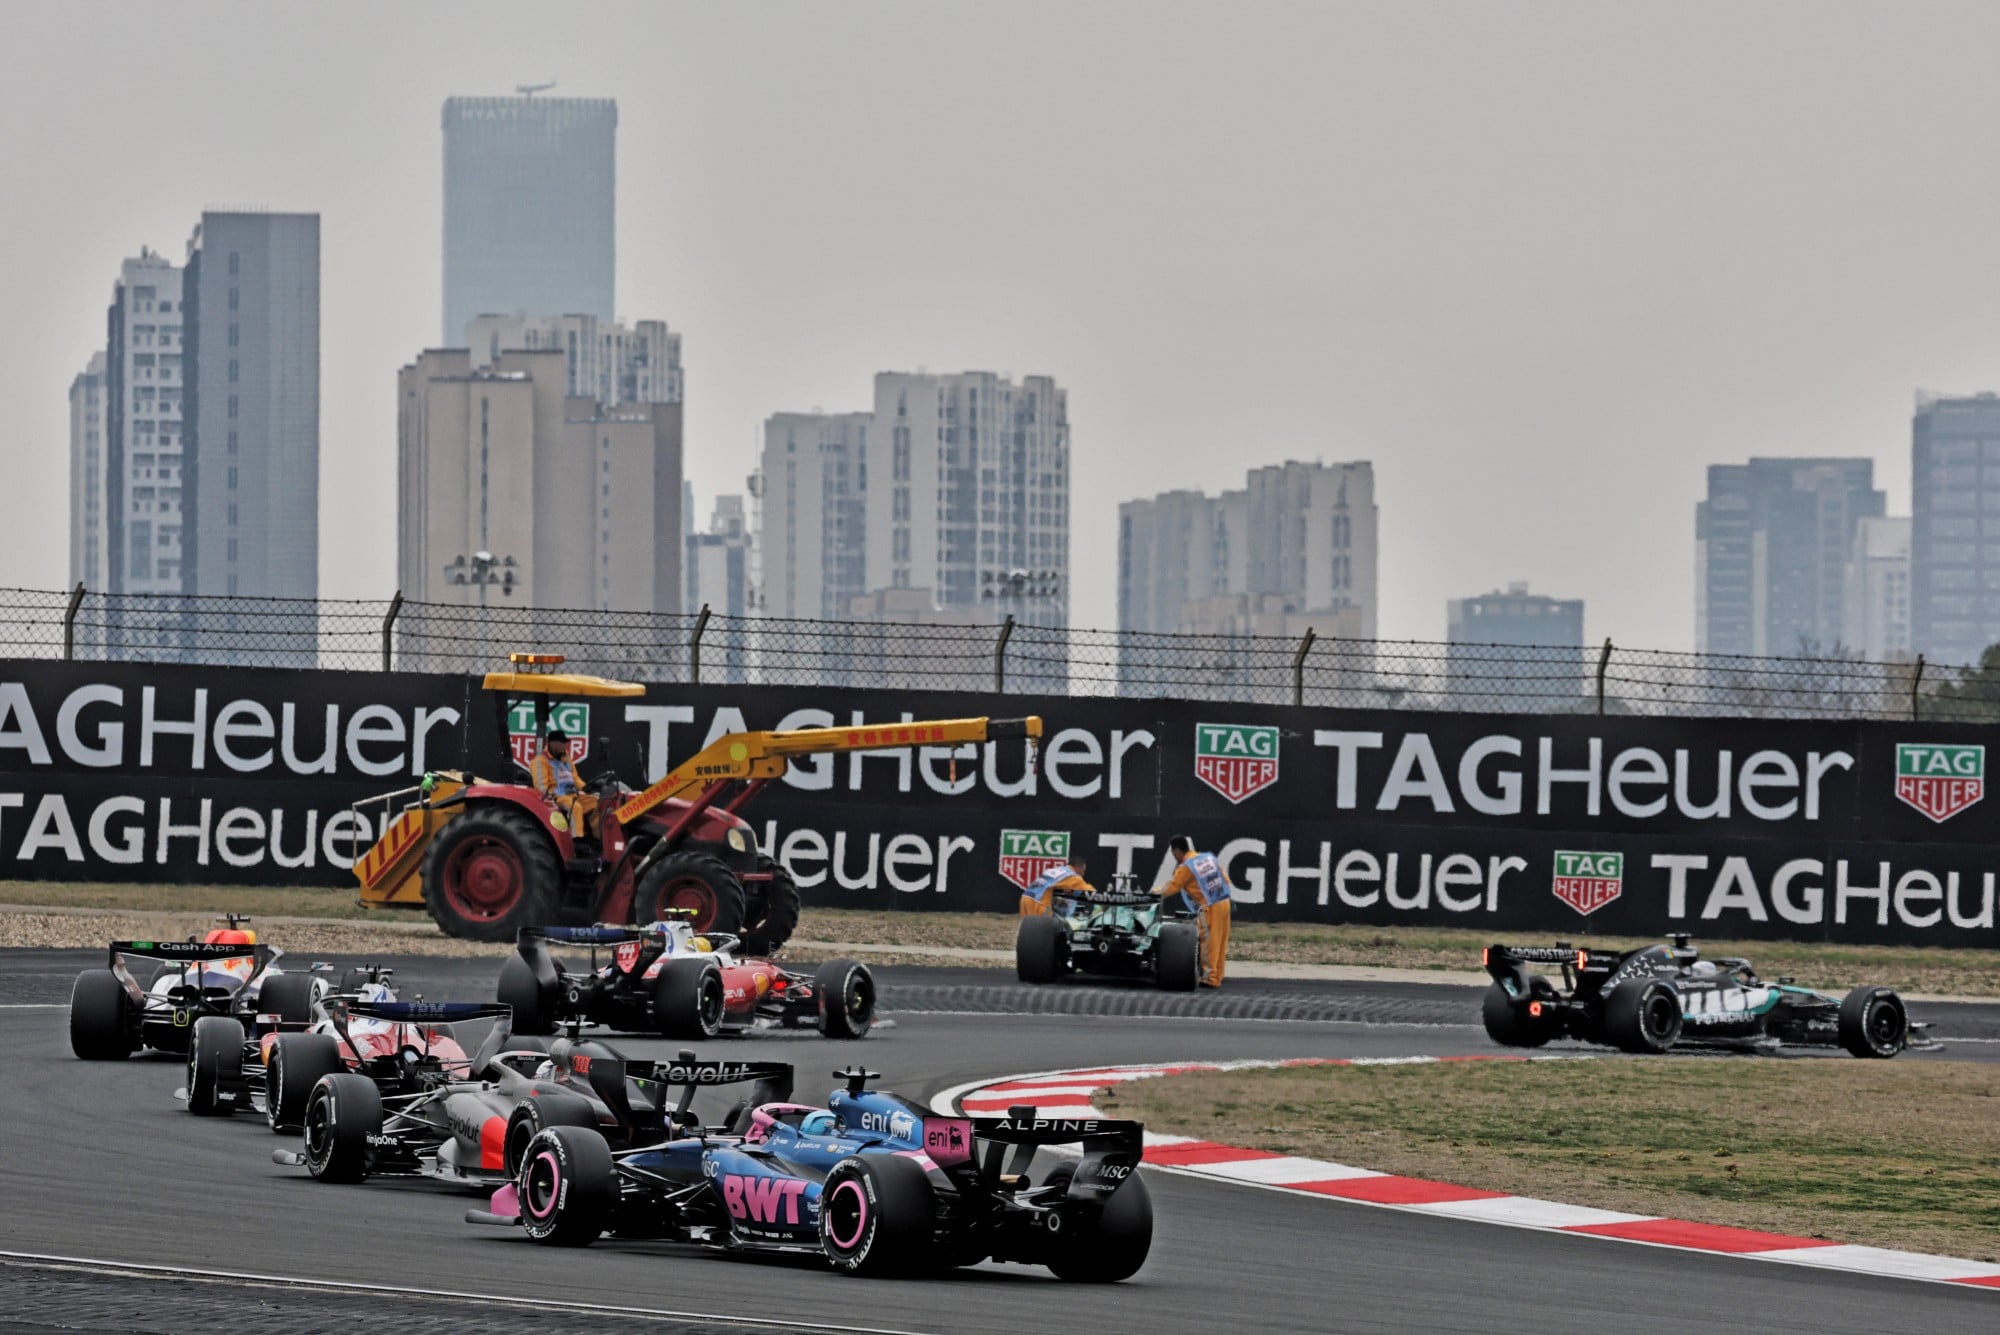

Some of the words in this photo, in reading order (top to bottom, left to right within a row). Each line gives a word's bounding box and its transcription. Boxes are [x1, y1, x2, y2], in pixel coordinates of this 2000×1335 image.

[461, 109, 519, 121] HYATT
[510, 737, 584, 768] HER
[1203, 728, 1271, 756] TAG
[1903, 749, 1977, 774] TAG
[1200, 758, 1273, 799] HEUER
[1313, 729, 1855, 821] TAGHeuer
[1900, 777, 1979, 817] HEUER
[1007, 834, 1064, 855] TAG
[1560, 855, 1617, 877] TAG
[1556, 878, 1618, 912] HEUER
[1651, 853, 2000, 929] TAGHeu
[159, 942, 199, 951] Cash
[202, 943, 235, 953] App
[618, 944, 636, 960] 44
[652, 1060, 750, 1083] Revolut
[861, 1109, 891, 1133] eni
[995, 1118, 1099, 1132] ALPINE
[366, 1134, 398, 1147] ninjaOne
[928, 1126, 948, 1148] eni
[1096, 1164, 1130, 1179] MSC
[723, 1174, 809, 1225] BWT
